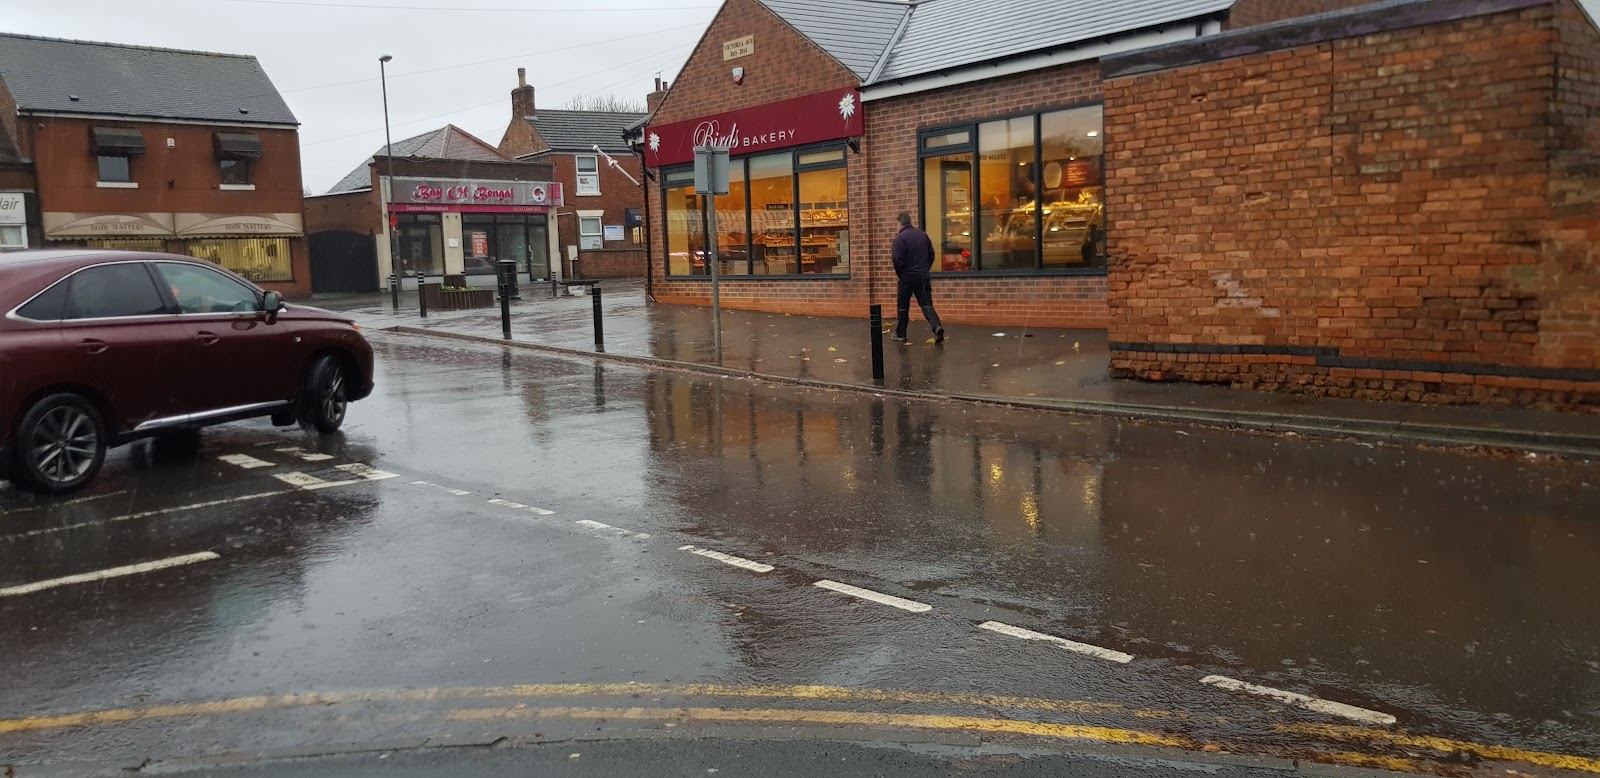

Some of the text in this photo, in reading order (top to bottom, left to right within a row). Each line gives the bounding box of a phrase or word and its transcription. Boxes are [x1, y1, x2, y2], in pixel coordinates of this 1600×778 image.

[723, 41, 744, 51] VICTORIA
[742, 129, 796, 147] BAKERY
[988, 153, 1007, 161] MEATS
[413, 184, 514, 201] Bay Of Bengal
[111, 223, 145, 231] MATTERS
[243, 223, 273, 231] MATTERS
